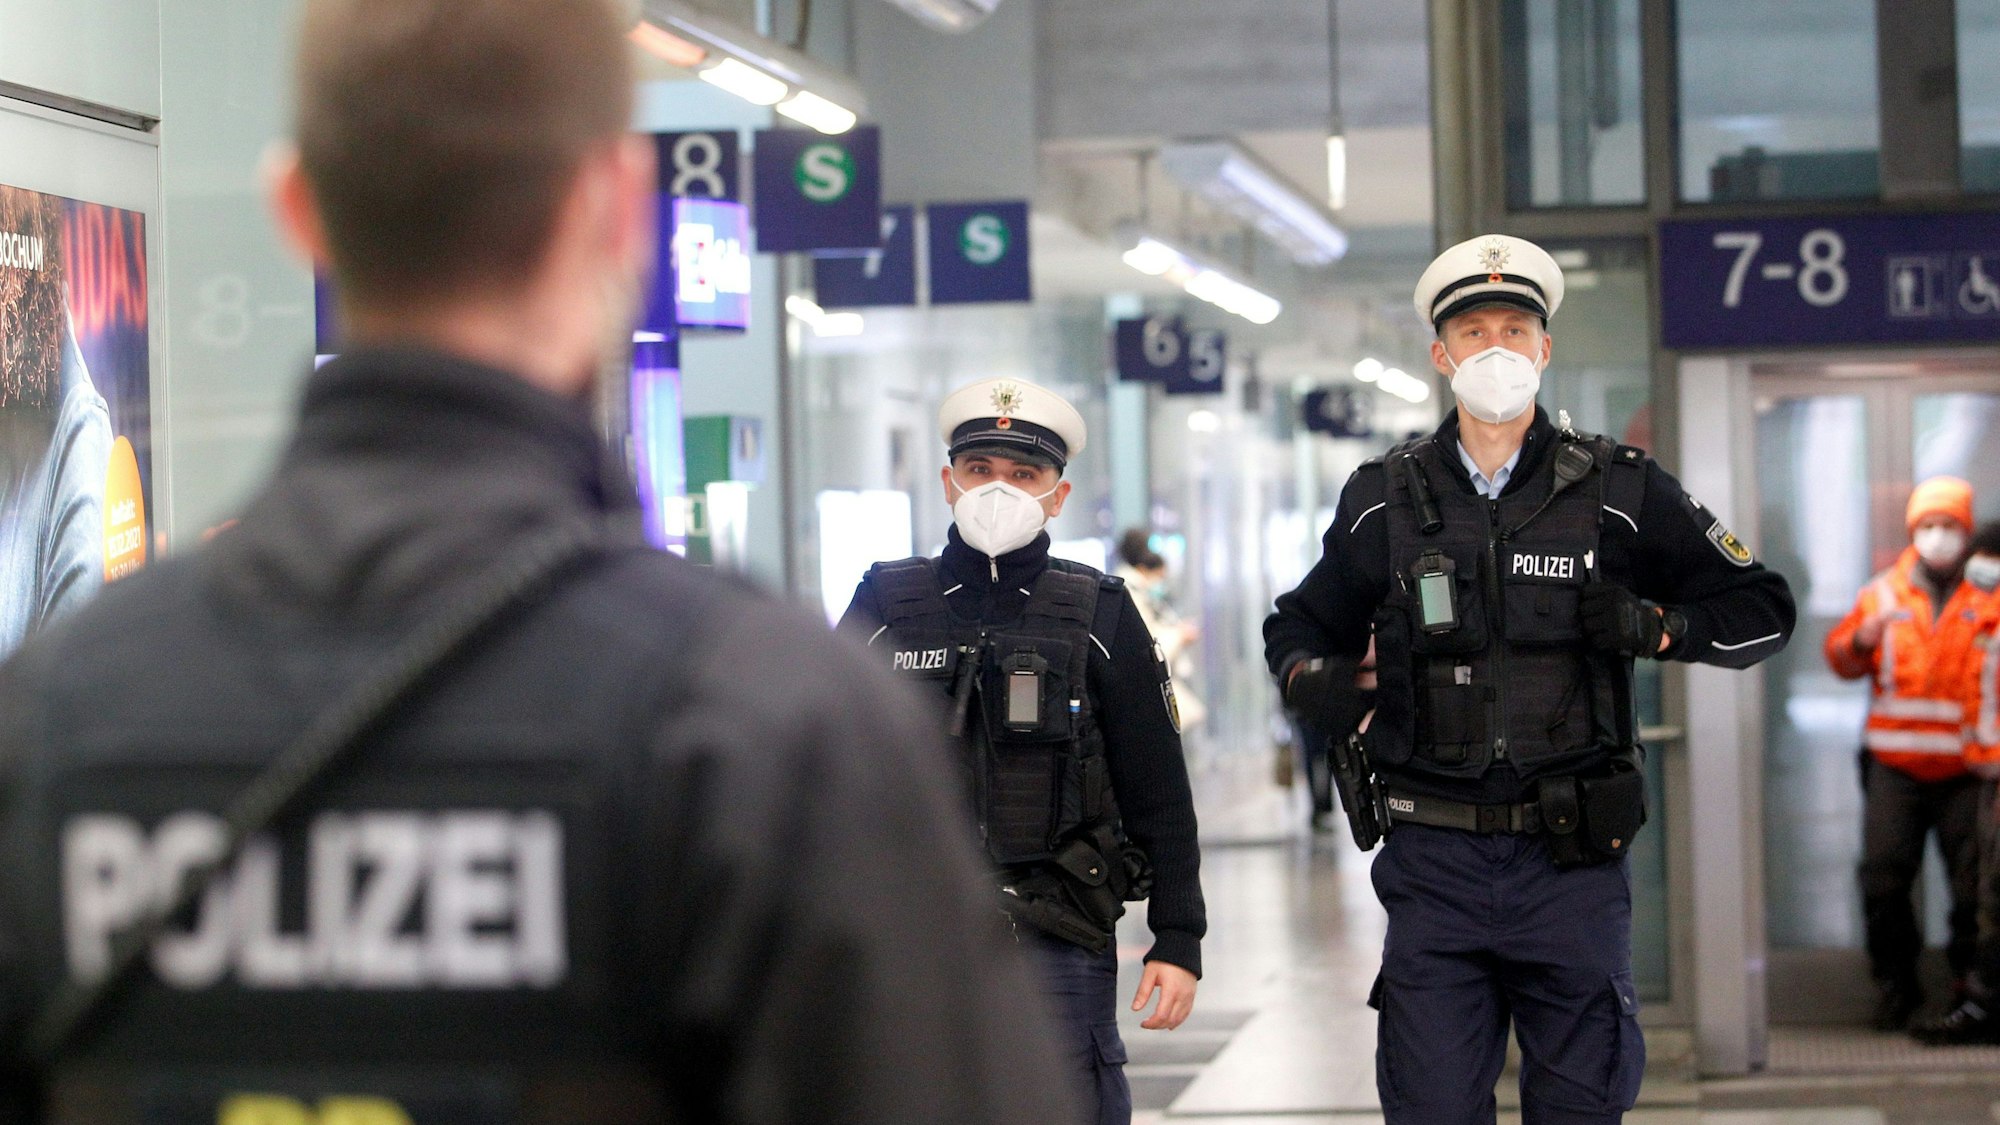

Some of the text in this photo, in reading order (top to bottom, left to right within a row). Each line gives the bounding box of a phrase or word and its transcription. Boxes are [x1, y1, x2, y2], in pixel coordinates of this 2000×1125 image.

[802, 144, 850, 200] S
[963, 214, 1005, 263] S
[1713, 229, 1849, 307] 7-8
[1143, 318, 1180, 367] 6
[1512, 553, 1574, 579] POLIZEI
[893, 648, 948, 670] POLIZEI
[61, 811, 568, 988] POLIZEI
